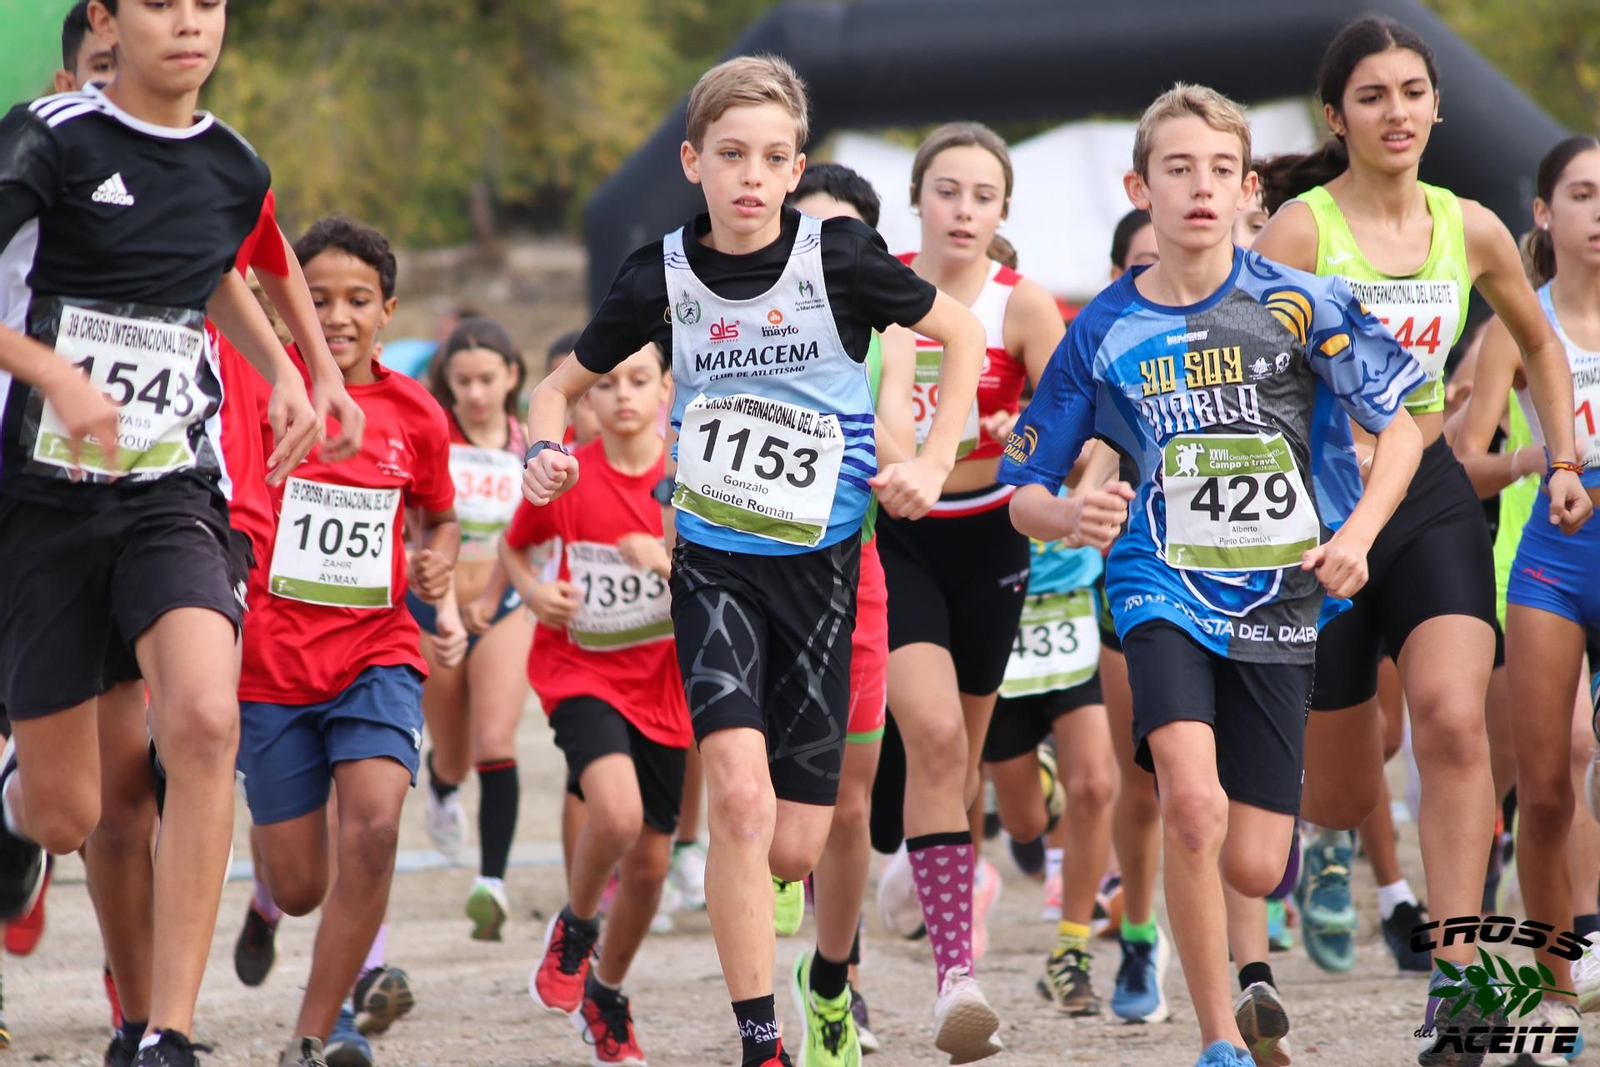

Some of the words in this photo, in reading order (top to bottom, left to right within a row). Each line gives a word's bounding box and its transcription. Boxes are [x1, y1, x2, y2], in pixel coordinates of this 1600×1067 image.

[91, 190, 135, 206] adidas
[1415, 284, 1429, 304] DEL
[1429, 284, 1452, 304] ACEITE
[66, 312, 79, 338] 39
[79, 315, 111, 344] CROSS
[110, 321, 177, 354] INTERNACIONAL
[709, 317, 740, 339] als
[761, 325, 800, 338] mayfo
[694, 340, 820, 373] MARACENA
[708, 372, 734, 382] CLUB
[736, 371, 749, 379] DE
[750, 365, 806, 378] ATLETISMO
[1139, 355, 1177, 398] YO
[1183, 345, 1245, 390] SOY
[115, 412, 151, 430] YASS
[733, 396, 798, 431] INTERNACIONAL
[796, 411, 814, 436] DEL
[698, 418, 819, 488] 1153
[1209, 448, 1229, 461] XXVII
[1209, 459, 1242, 470] Campo
[1251, 456, 1276, 467] travé
[722, 474, 770, 496] Gonzálo
[701, 484, 744, 507] Guiote
[746, 497, 795, 521] Román
[1190, 472, 1298, 523] 429
[293, 513, 386, 559] 1053
[1231, 525, 1258, 534] Alberto
[322, 558, 353, 570] ZAHIR
[318, 572, 359, 586] AYMAN
[581, 569, 666, 608] 1393
[1238, 623, 1274, 642] DEL
